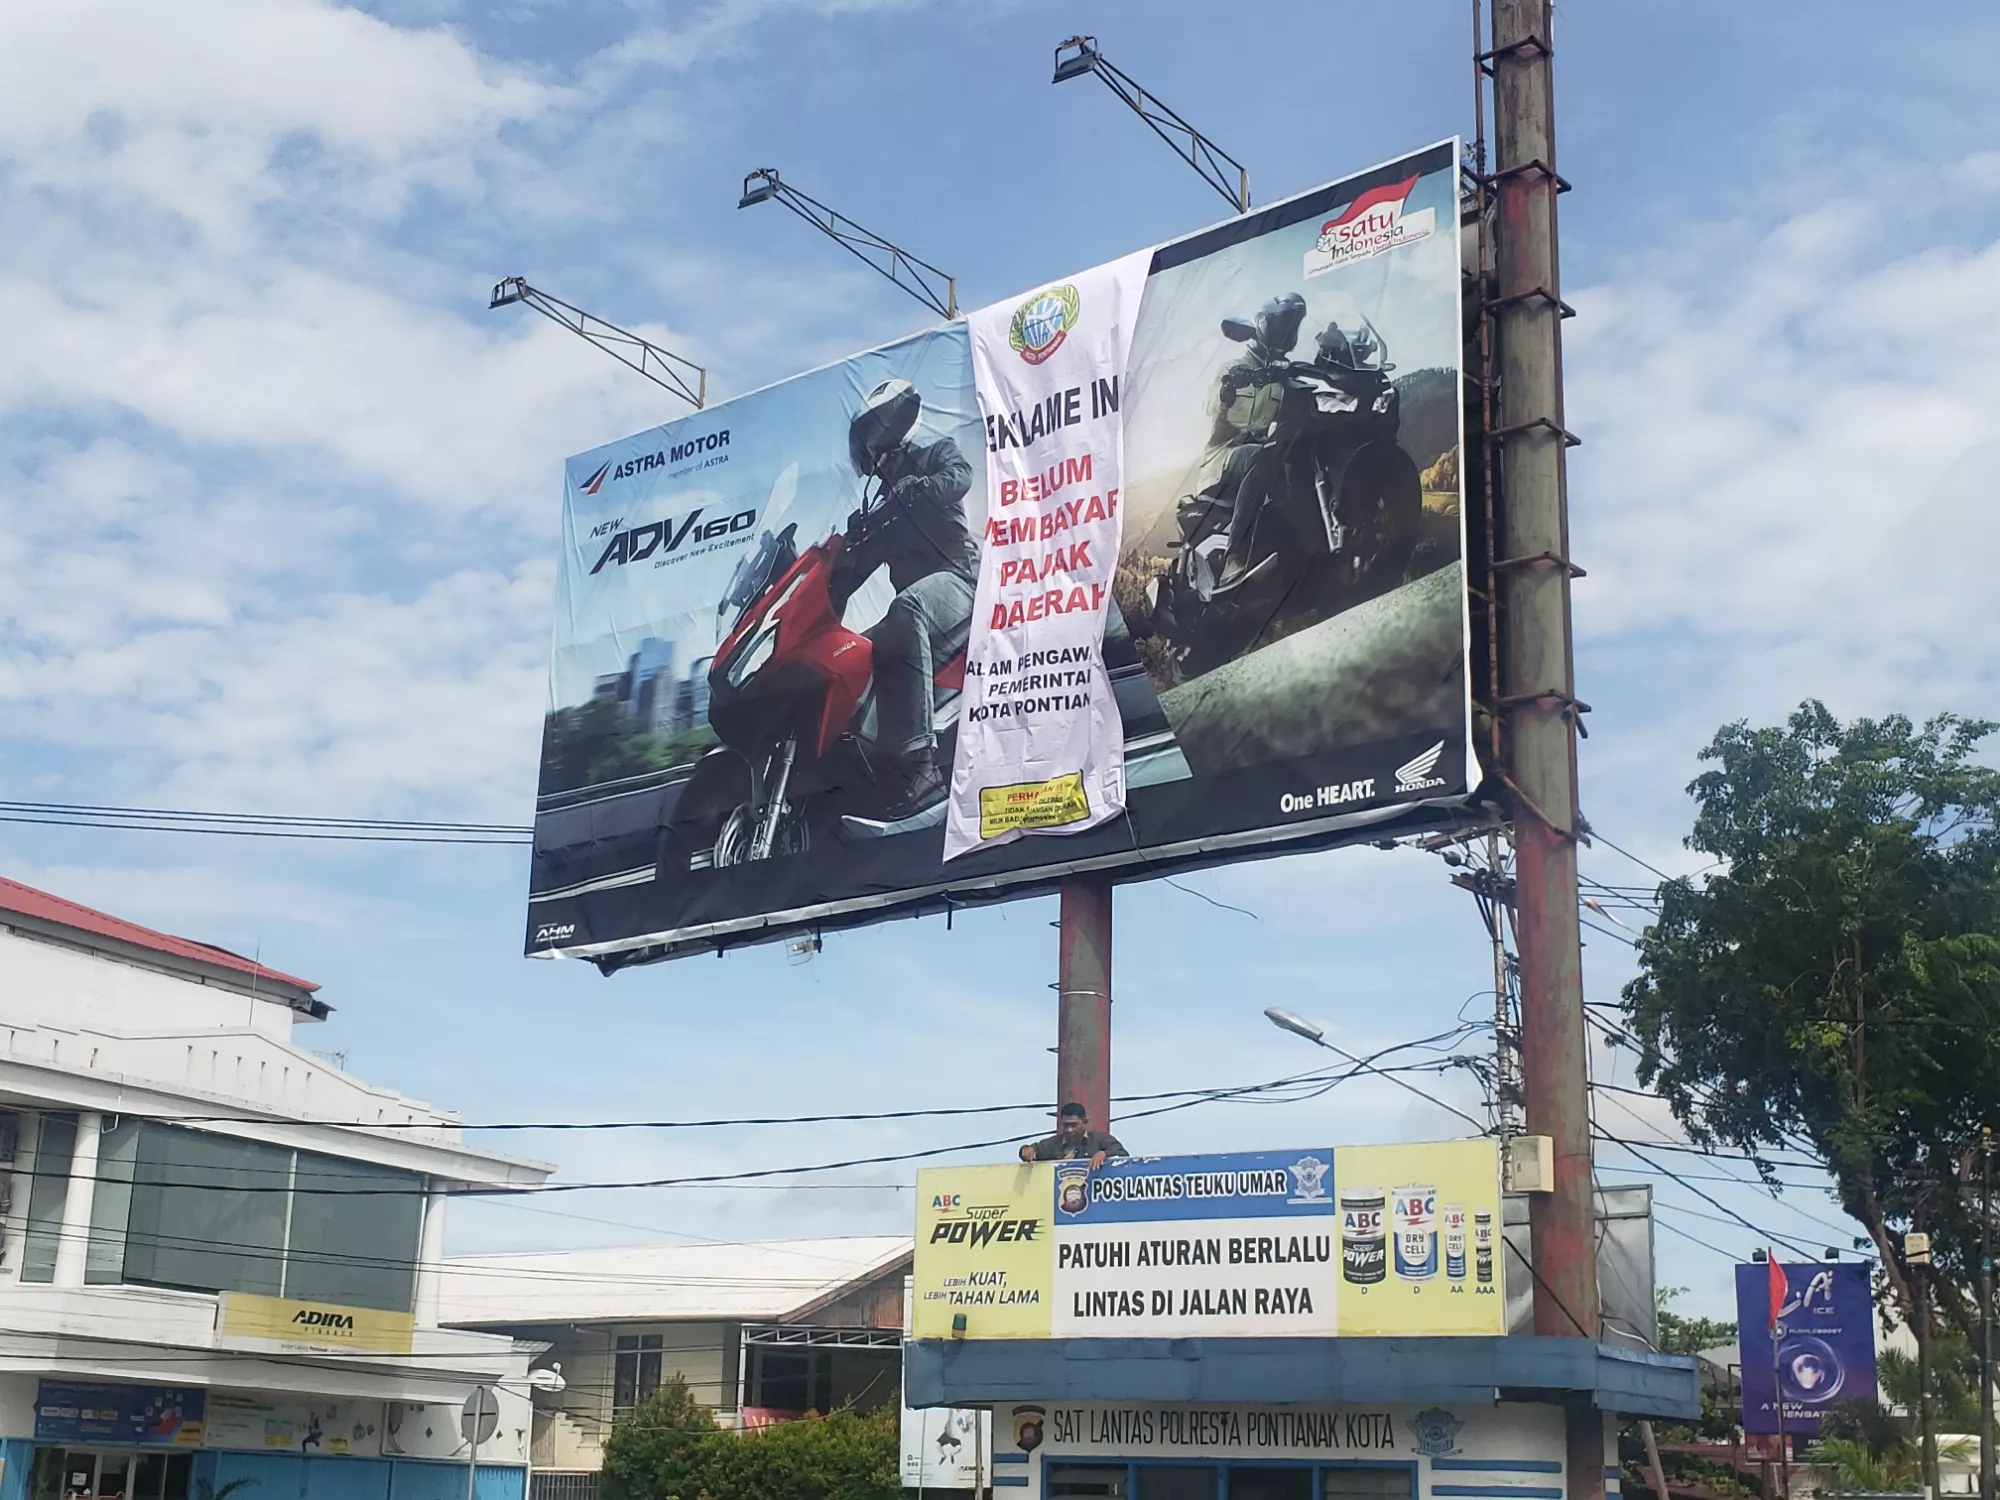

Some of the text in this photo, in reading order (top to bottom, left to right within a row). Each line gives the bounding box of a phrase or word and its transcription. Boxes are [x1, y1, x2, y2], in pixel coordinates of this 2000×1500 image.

[1340, 212, 1394, 242] satu
[1331, 225, 1403, 260] Indonesia
[1091, 375, 1119, 419] IN
[613, 430, 731, 481] ASTRA MOTOR
[704, 454, 729, 468] ASTRA
[1001, 453, 1092, 506] BELUM
[589, 517, 625, 539] NEW
[654, 533, 755, 569] Discover New Excitement
[1000, 540, 1093, 587] PAJAK
[1018, 646, 1092, 673] PENGAW
[968, 703, 1011, 722] KOTA
[1395, 777, 1447, 794] HONDA
[1280, 778, 1376, 813] One HEART.
[536, 924, 575, 938] AHM
[1093, 1171, 1286, 1201] POS LANTAS TEUKU UMAR
[932, 1195, 961, 1208] ABC
[1395, 1197, 1435, 1217] ABC
[966, 1206, 1009, 1221] Super
[1345, 1212, 1381, 1229] ABC
[1445, 1213, 1465, 1224] ABC
[930, 1219, 1044, 1250] POWER
[1405, 1233, 1425, 1243] DRY
[1058, 1236, 1331, 1269] PATUHI ATURAN BERLALU
[1344, 1249, 1385, 1268] POWER
[1405, 1244, 1427, 1255] CELL
[943, 1271, 1008, 1288] LEBIH KUAT,
[924, 1289, 1040, 1306] LEBIH TAHAN LAMA
[1361, 1286, 1368, 1295] D
[1414, 1286, 1421, 1294] D
[1451, 1286, 1464, 1294] AA
[1475, 1286, 1496, 1294] AAA
[1073, 1287, 1314, 1318] LINTAS DI JALAN RAYA
[1813, 1306, 1834, 1315] ICE
[292, 1311, 353, 1329] ADIRA
[1054, 1410, 1394, 1449] SAT LANTAS POLRESTA PONTIANAK KOTA
